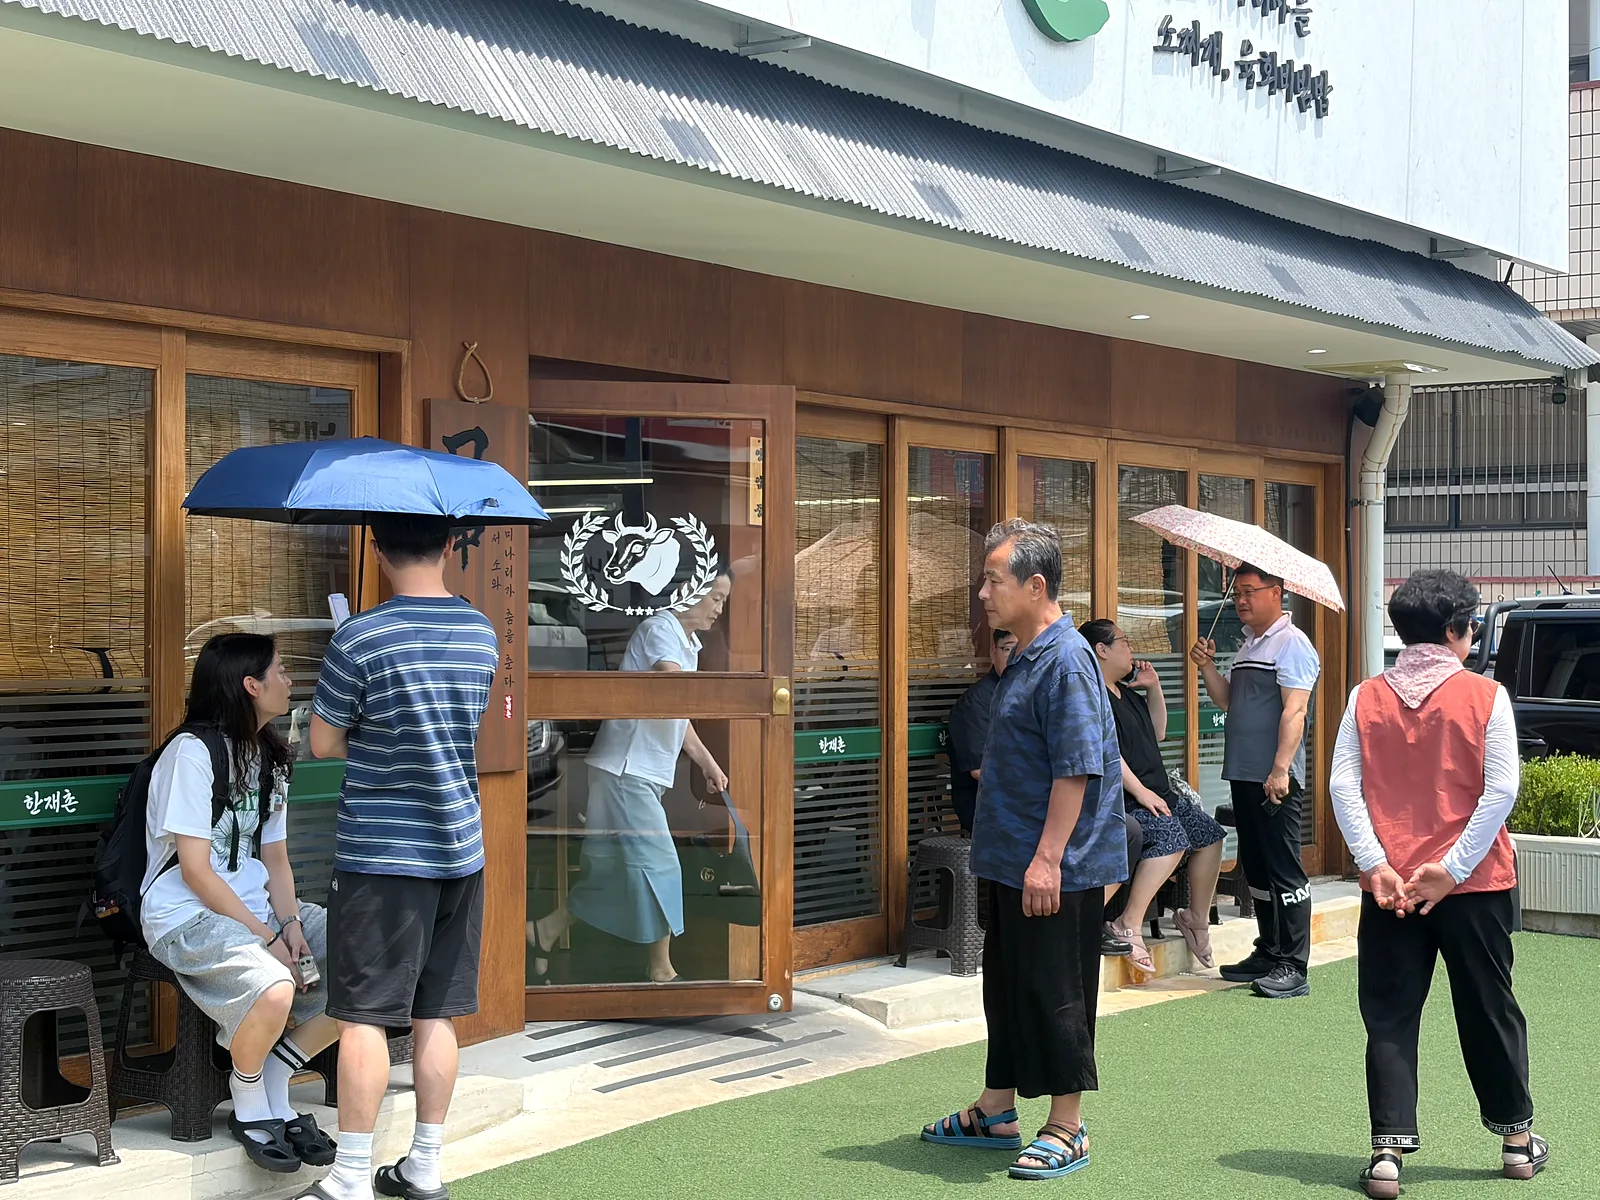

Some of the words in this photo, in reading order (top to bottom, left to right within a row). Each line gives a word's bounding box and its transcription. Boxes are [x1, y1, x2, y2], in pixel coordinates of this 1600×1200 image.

[1234, 39, 1333, 118] 육회비빔밥
[491, 559, 502, 591] 소와
[504, 527, 515, 598] 미나리가
[504, 608, 515, 644] 춤을
[504, 653, 515, 688] 춘다
[818, 735, 846, 754] 한재촌
[23, 788, 79, 815] 한재촌
